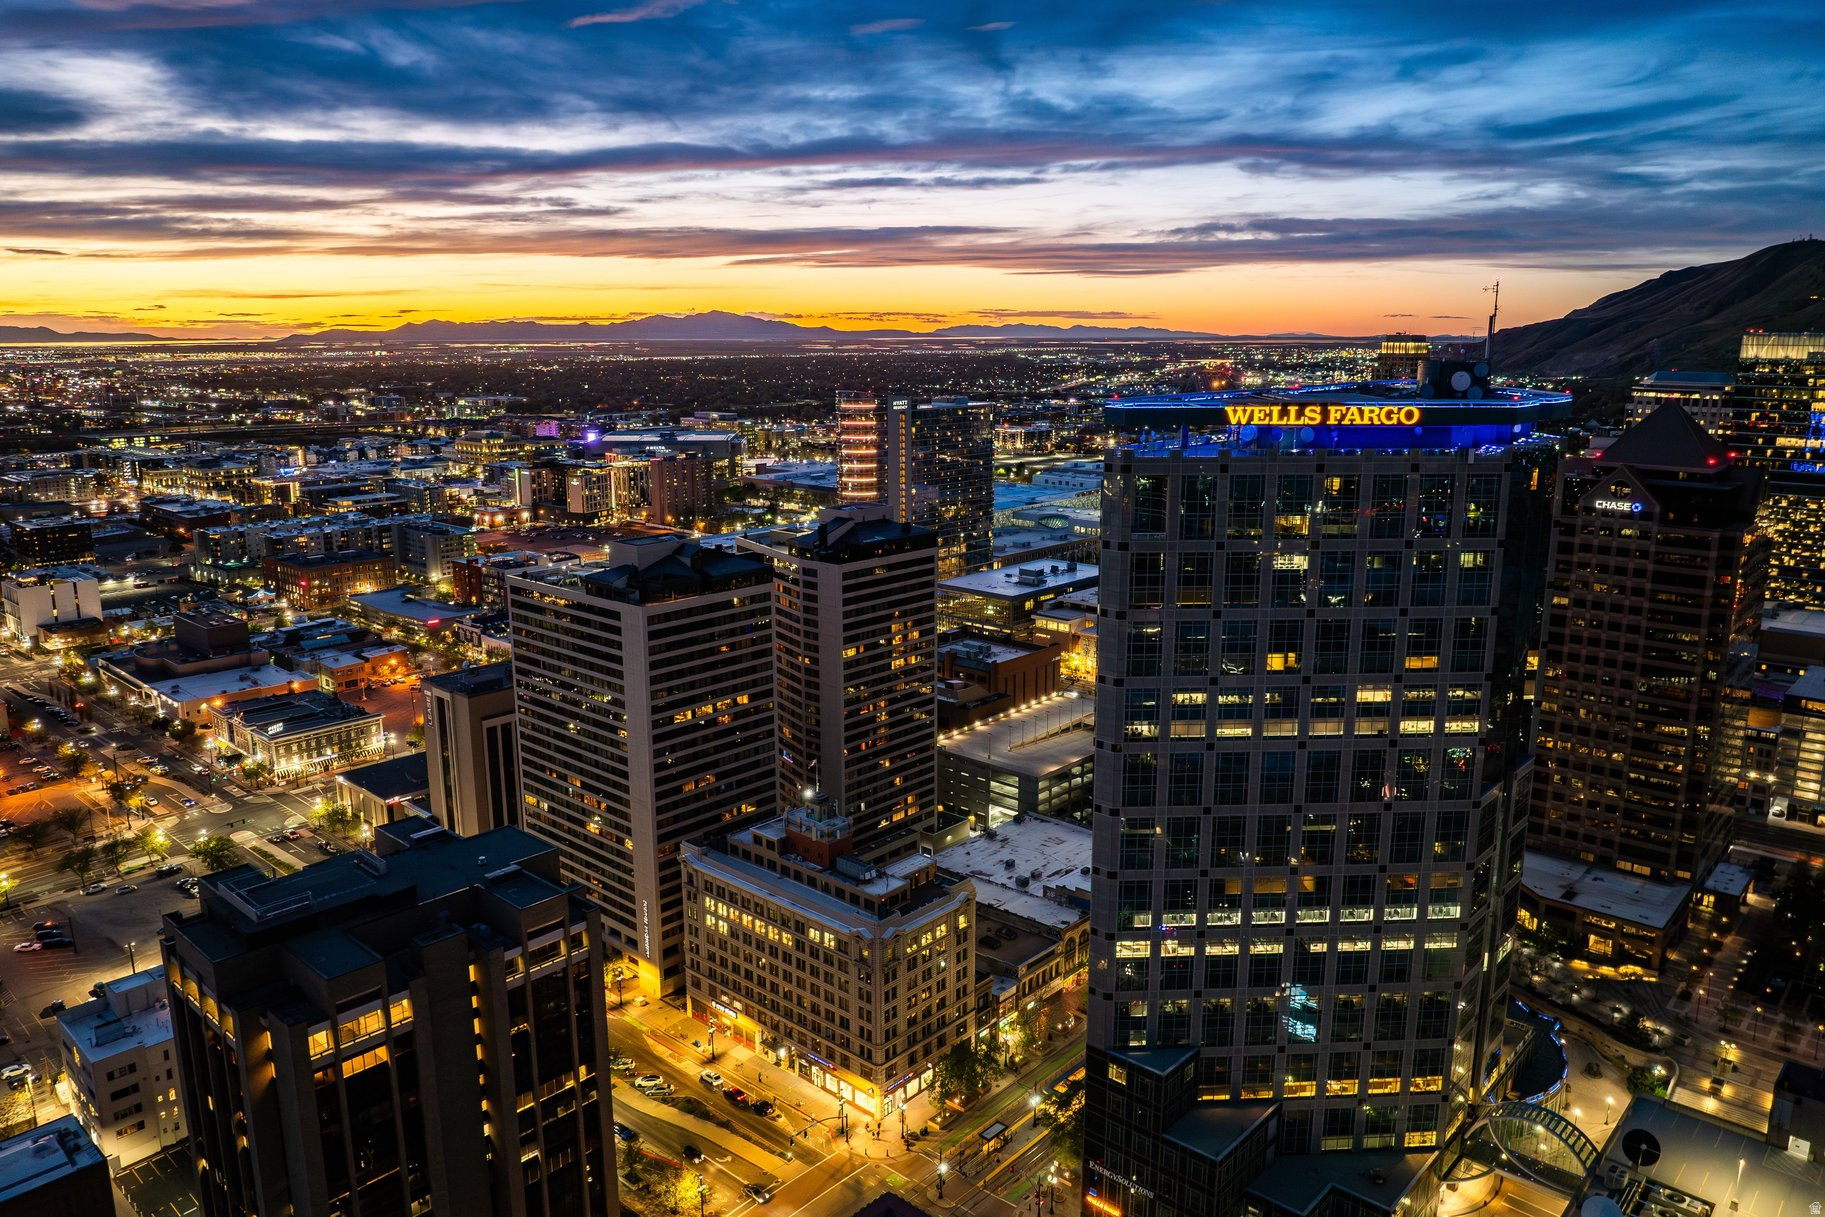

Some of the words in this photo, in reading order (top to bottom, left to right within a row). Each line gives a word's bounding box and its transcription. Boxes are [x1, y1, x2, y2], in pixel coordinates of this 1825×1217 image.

[1225, 405, 1321, 425] WELLS
[1326, 405, 1421, 425] FARGO
[1594, 500, 1632, 511] CHASE
[1089, 1160, 1155, 1200] ENERGYSOLUTIONS
